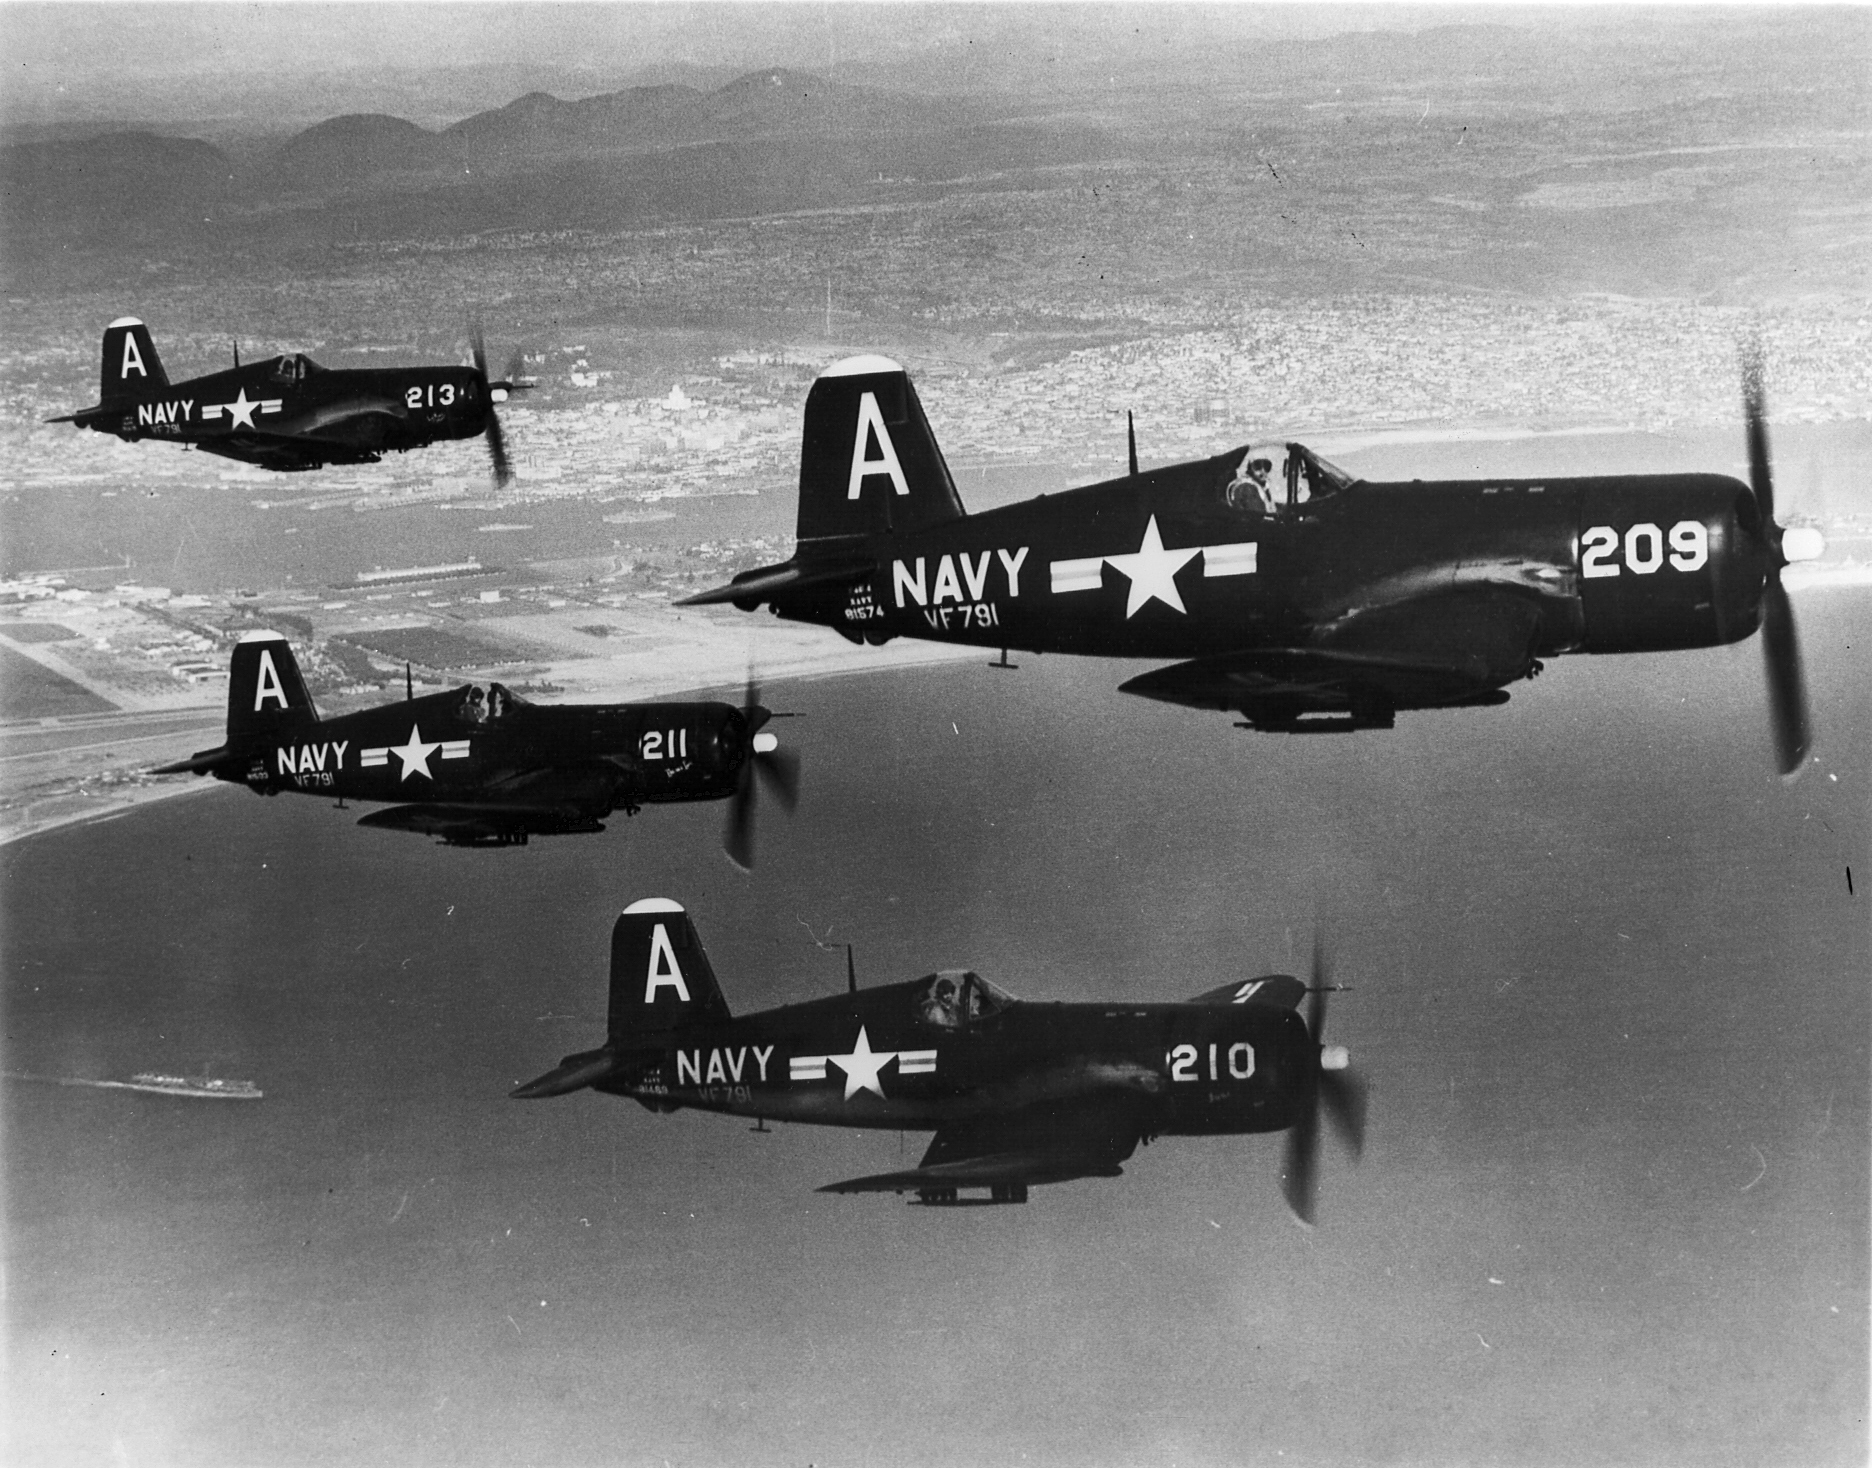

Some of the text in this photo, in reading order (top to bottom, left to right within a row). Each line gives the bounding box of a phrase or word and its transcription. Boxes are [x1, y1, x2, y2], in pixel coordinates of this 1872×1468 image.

[122, 332, 147, 378] A
[139, 400, 193, 425] NAVY
[407, 384, 455, 408] 213
[848, 392, 910, 499] A
[1581, 521, 1708, 578] 209
[893, 547, 1029, 608] NAVY
[255, 650, 288, 711] A
[277, 740, 348, 774] NAVY
[643, 728, 687, 760] 211
[645, 923, 690, 1003] A
[677, 1045, 774, 1085] NAVY
[1171, 1042, 1256, 1081] 210
